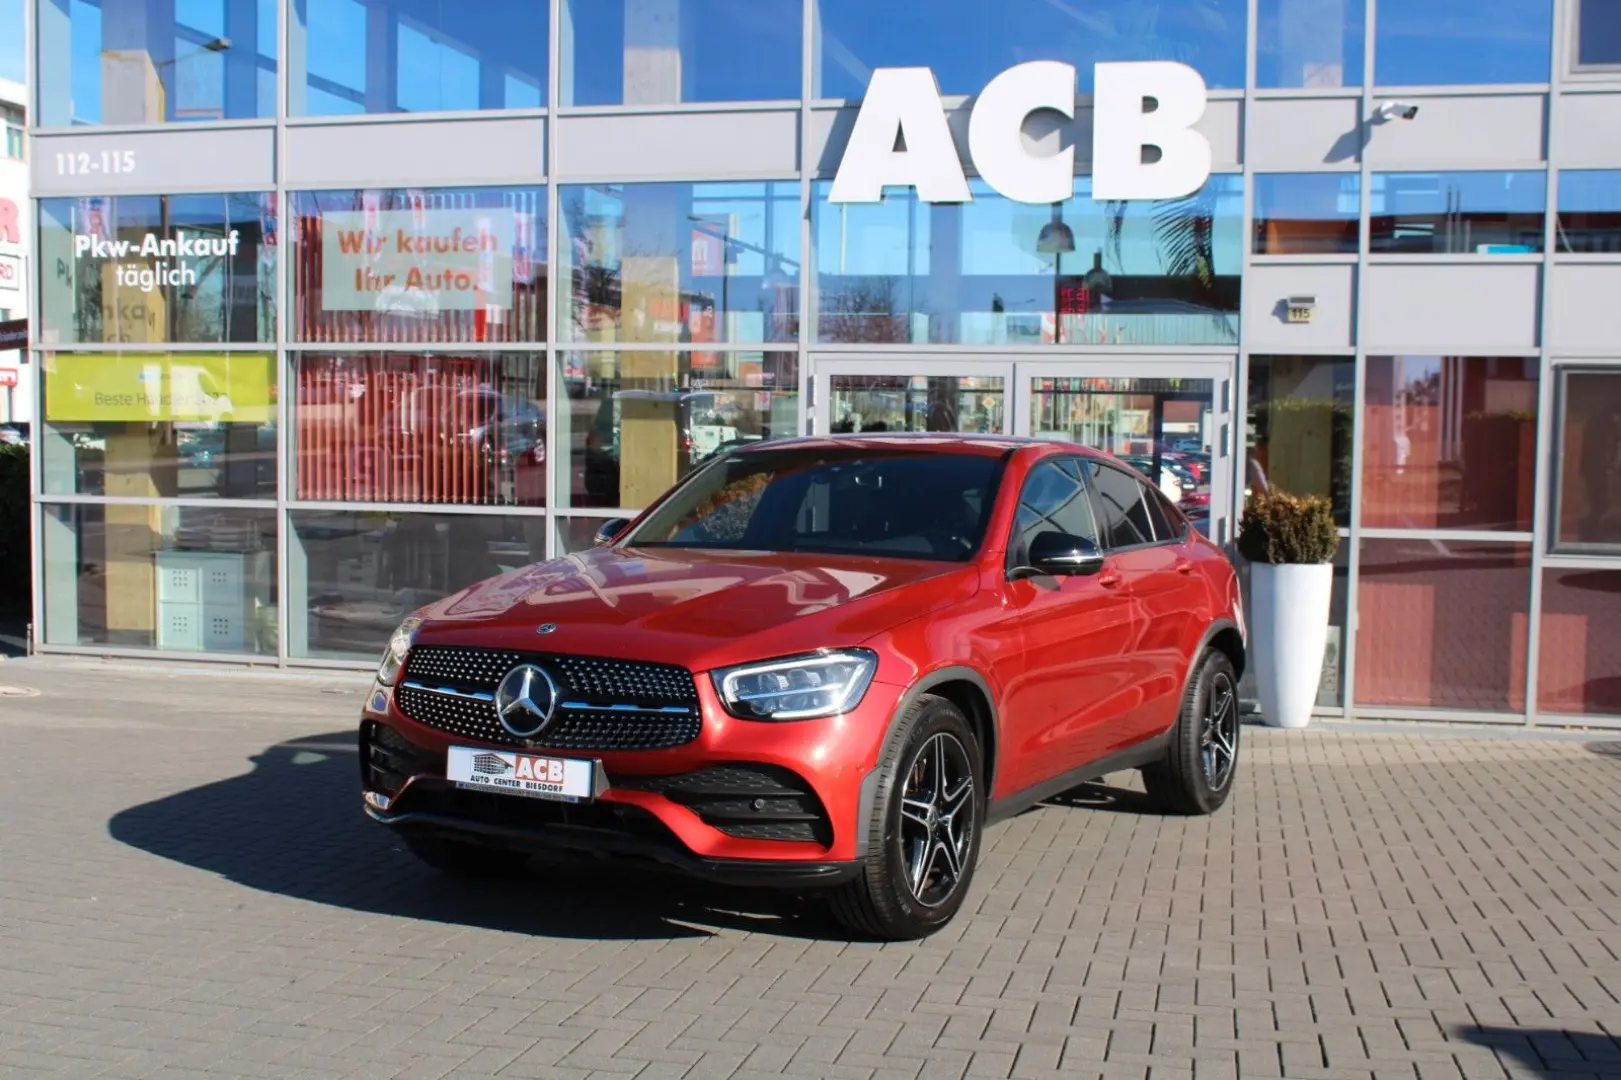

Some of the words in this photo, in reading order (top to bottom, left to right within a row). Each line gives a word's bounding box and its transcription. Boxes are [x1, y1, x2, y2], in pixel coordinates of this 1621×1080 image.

[827, 60, 1212, 205] ACB
[56, 150, 136, 176] 112-115
[75, 231, 240, 258] Pkw-Ankauf
[337, 230, 388, 255] Wir
[396, 227, 498, 255] kaufen
[116, 262, 196, 292] täglich
[355, 267, 396, 292] Ihr
[404, 266, 480, 292] Auto.
[94, 391, 133, 406] Beste
[516, 757, 564, 783] ACB
[470, 775, 490, 784] AUTO
[494, 779, 521, 788] CENTER
[525, 783, 563, 793] BIESDORF
